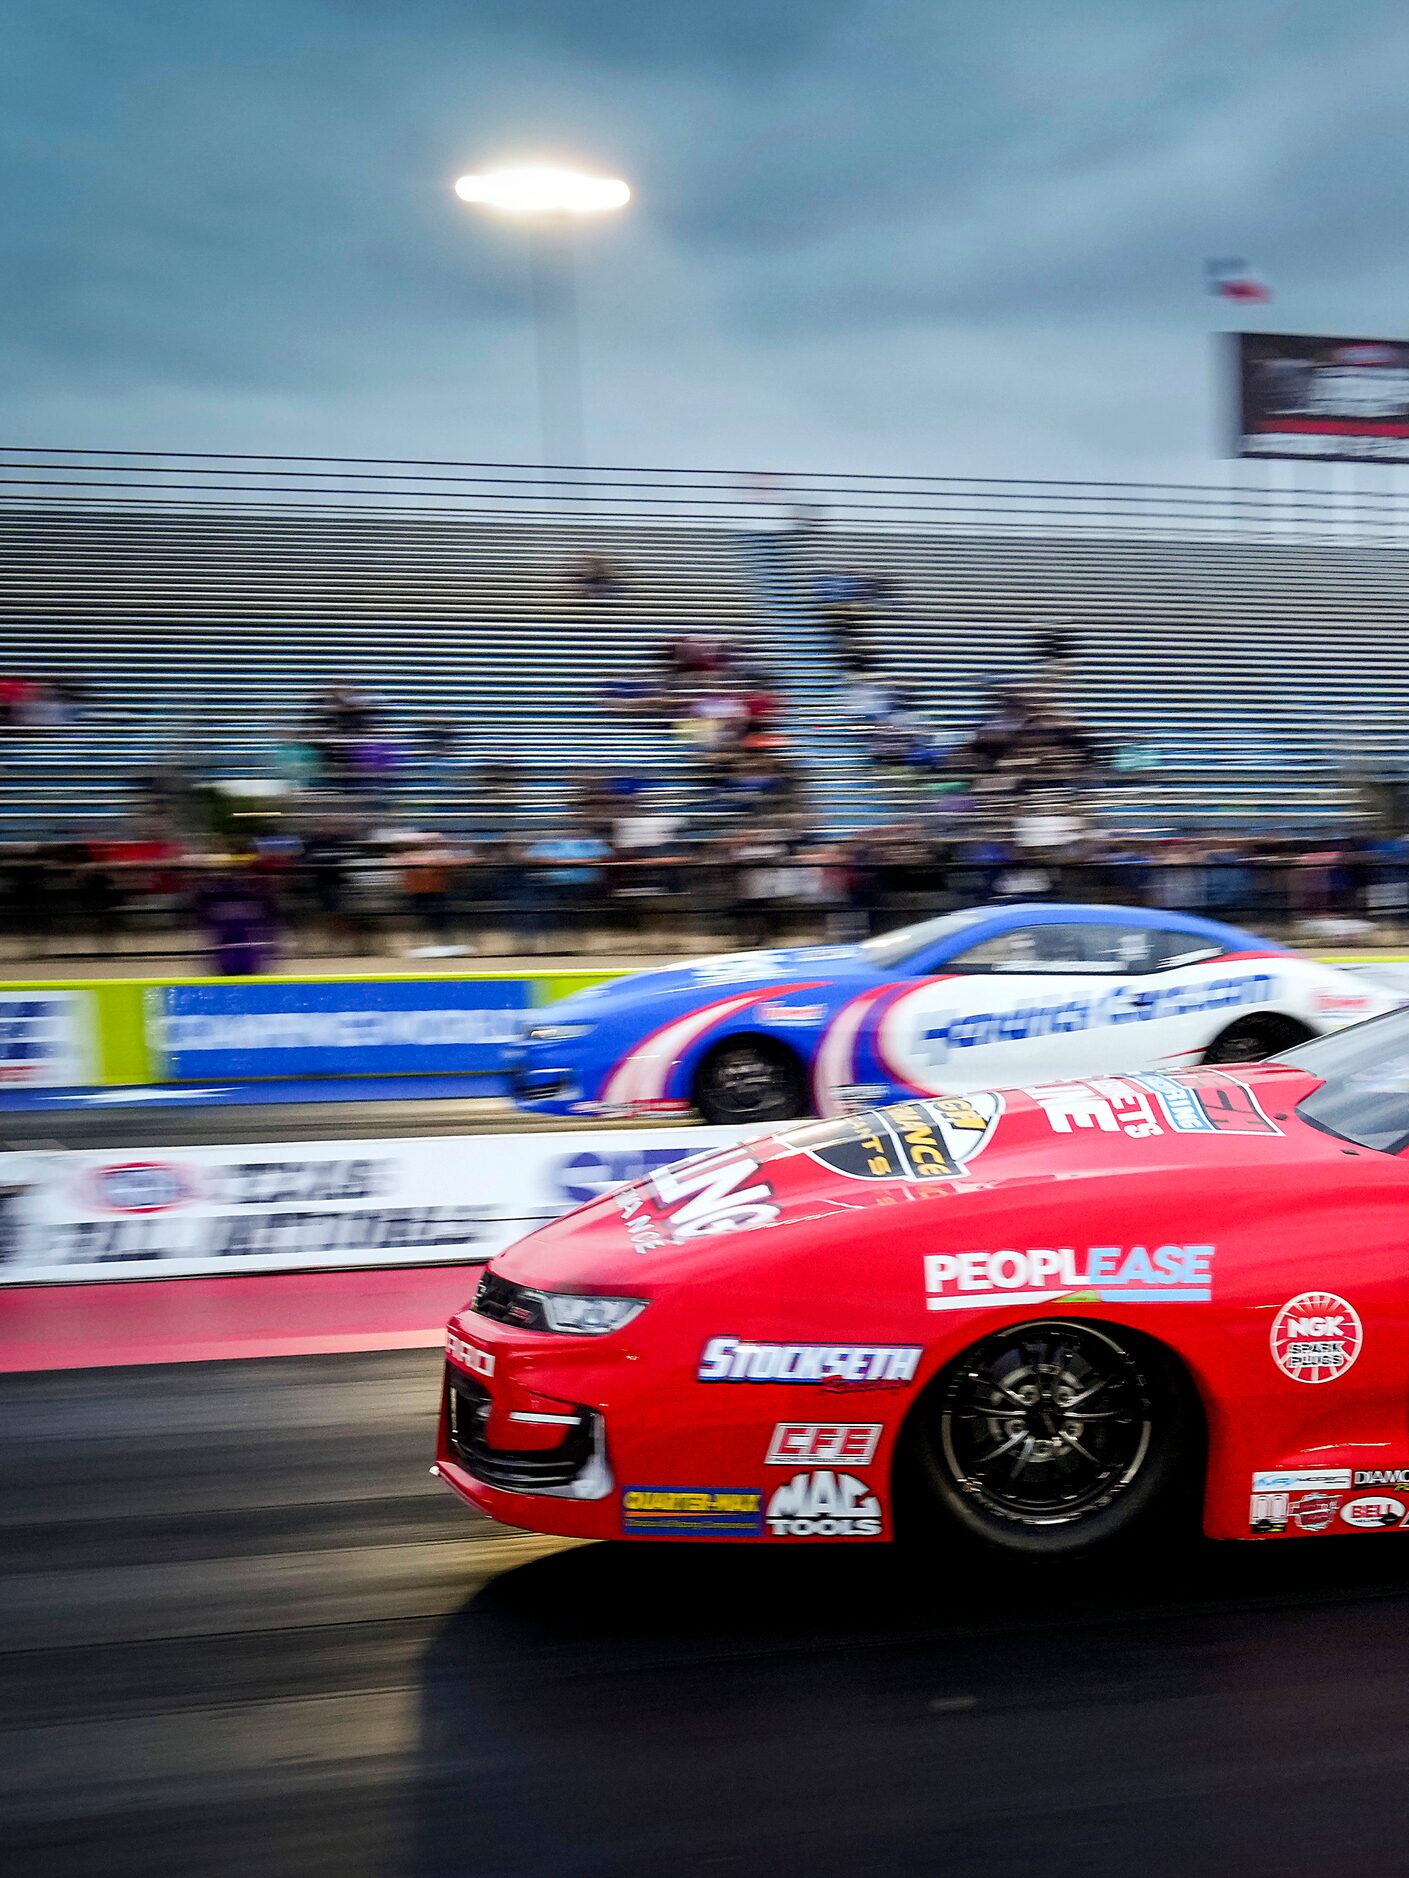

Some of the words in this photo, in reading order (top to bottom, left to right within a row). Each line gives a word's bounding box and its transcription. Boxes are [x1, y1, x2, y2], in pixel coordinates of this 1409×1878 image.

[924, 1246, 1215, 1292] PEOPLEASE
[1287, 1316, 1344, 1337] NGK
[699, 1336, 923, 1381] STOCKSETH
[1288, 1342, 1342, 1354] SPARK
[1288, 1354, 1343, 1366] PLUGS
[776, 1428, 872, 1455] CFE
[766, 1470, 882, 1517] MAC
[1351, 1504, 1391, 1519] BELL
[766, 1518, 882, 1536] TOOLS
